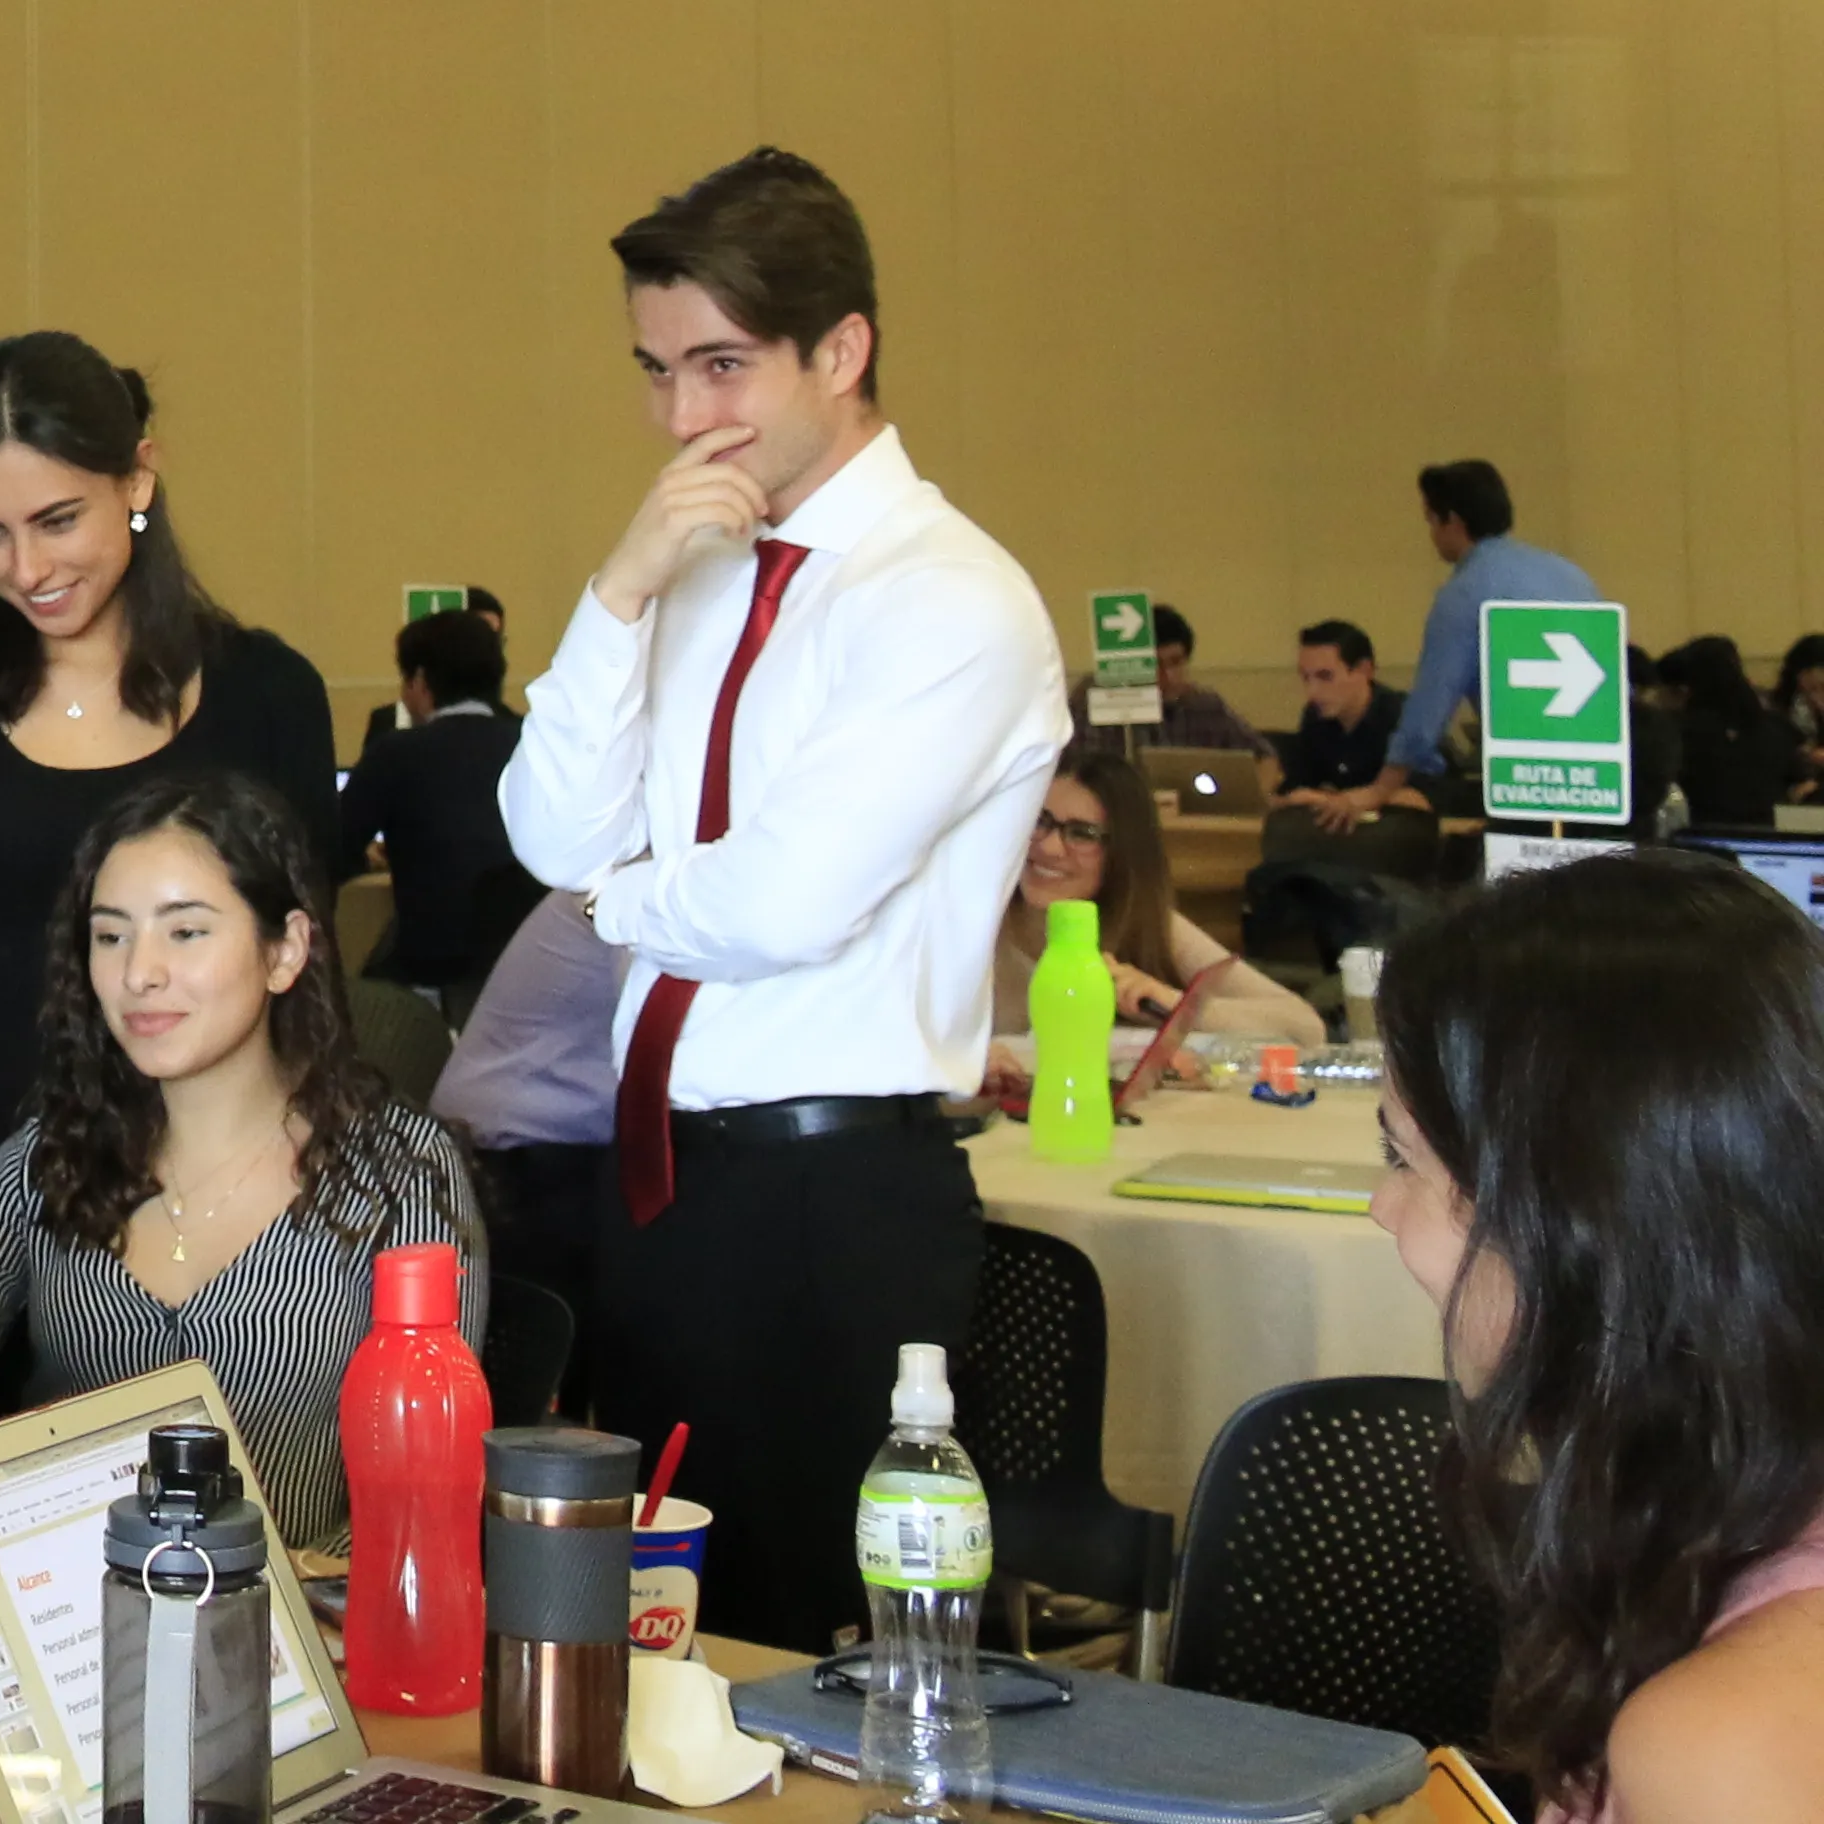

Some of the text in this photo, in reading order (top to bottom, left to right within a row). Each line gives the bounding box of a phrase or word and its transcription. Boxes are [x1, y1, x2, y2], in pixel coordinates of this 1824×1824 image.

[1512, 764, 1597, 787] RUTA DE
[1492, 783, 1619, 807] EVACUACION
[16, 1567, 53, 1593] Alcance
[636, 1614, 682, 1641] DQ
[42, 1636, 76, 1656] Personal
